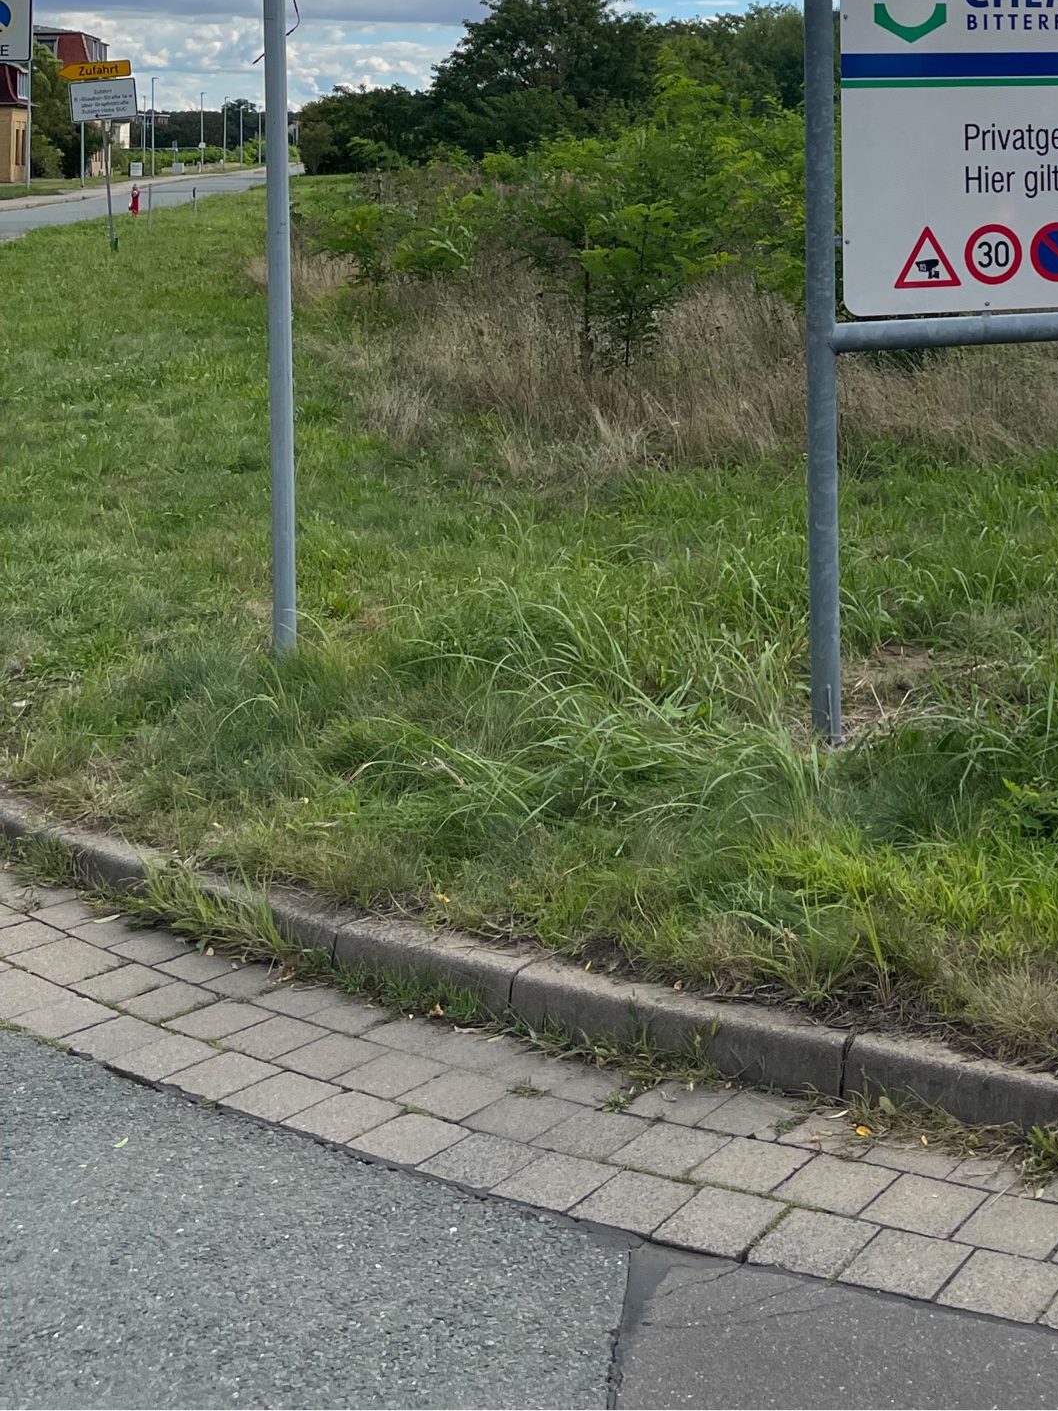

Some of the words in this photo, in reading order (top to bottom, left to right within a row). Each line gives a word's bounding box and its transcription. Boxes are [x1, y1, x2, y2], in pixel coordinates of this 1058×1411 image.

[78, 64, 119, 76] Zufahrt
[965, 165, 1015, 193] Hier
[977, 240, 1010, 268] 30
